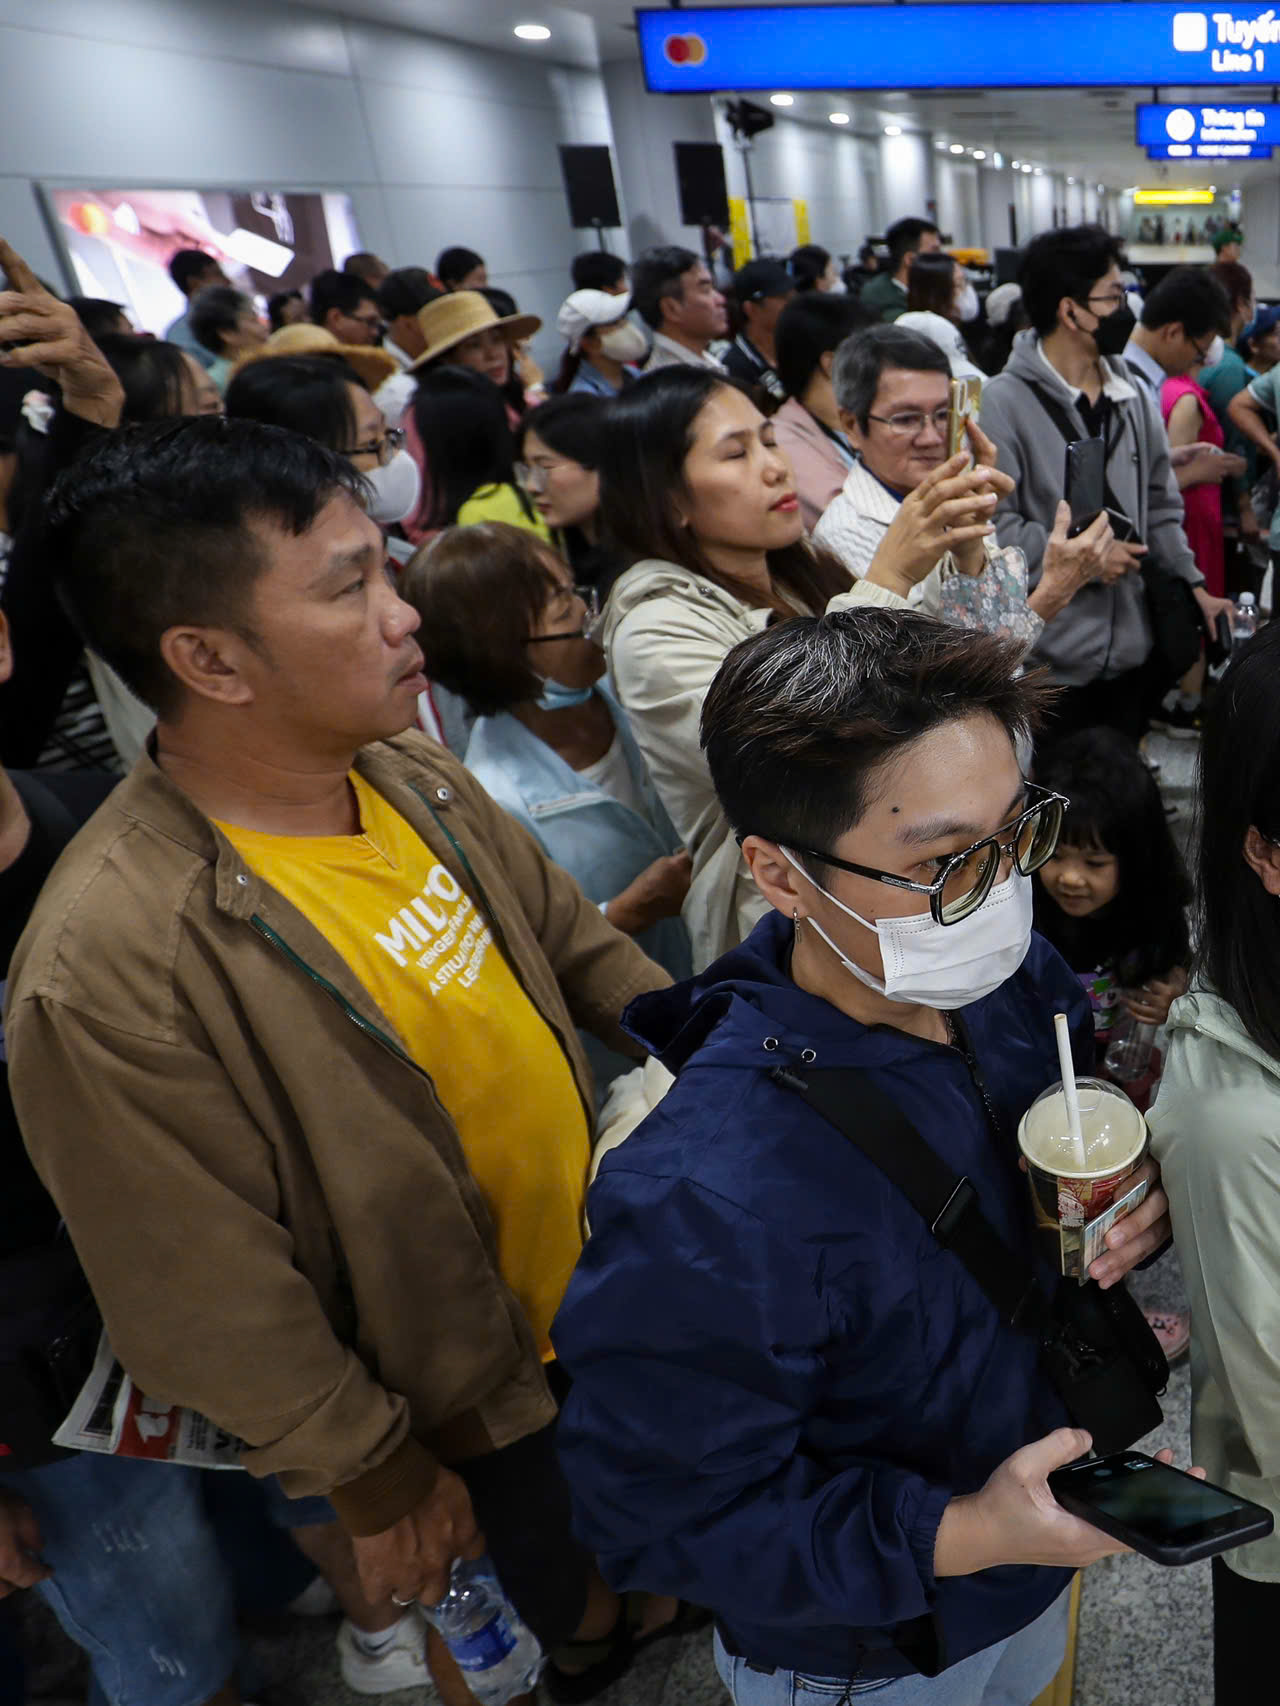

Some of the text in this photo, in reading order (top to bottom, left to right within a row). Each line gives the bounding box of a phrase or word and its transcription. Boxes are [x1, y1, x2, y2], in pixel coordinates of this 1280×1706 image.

[1211, 49, 1265, 72] Line 1
[429, 980, 442, 998] A
